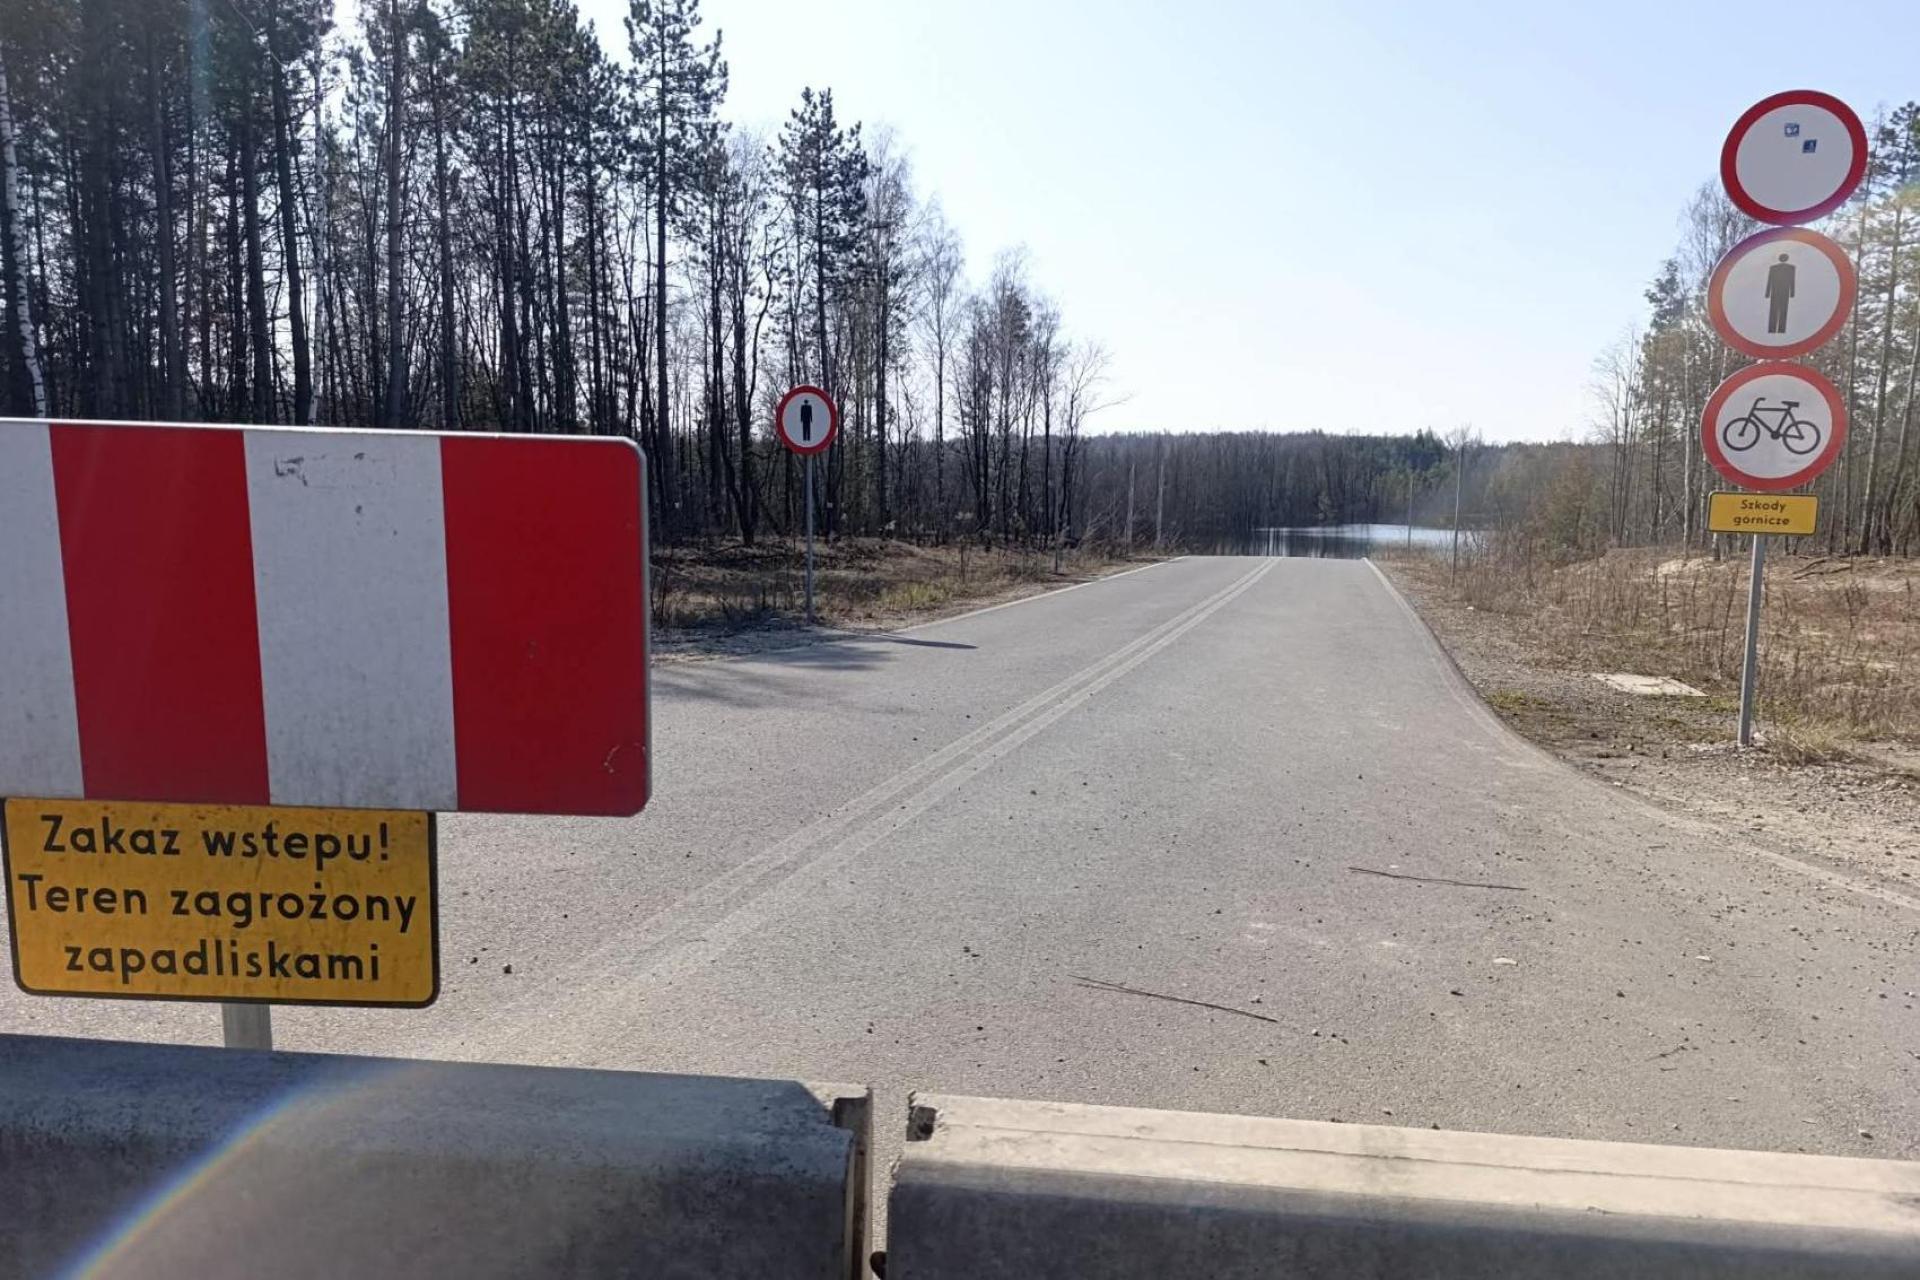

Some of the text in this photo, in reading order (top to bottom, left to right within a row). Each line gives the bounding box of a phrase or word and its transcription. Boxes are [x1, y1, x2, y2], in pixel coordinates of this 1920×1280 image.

[1740, 499, 1786, 513] Szkody
[40, 814, 389, 871] Zakaz wstepu!
[17, 873, 417, 933] Teren zagrożony
[64, 938, 380, 985] zapadliskami
